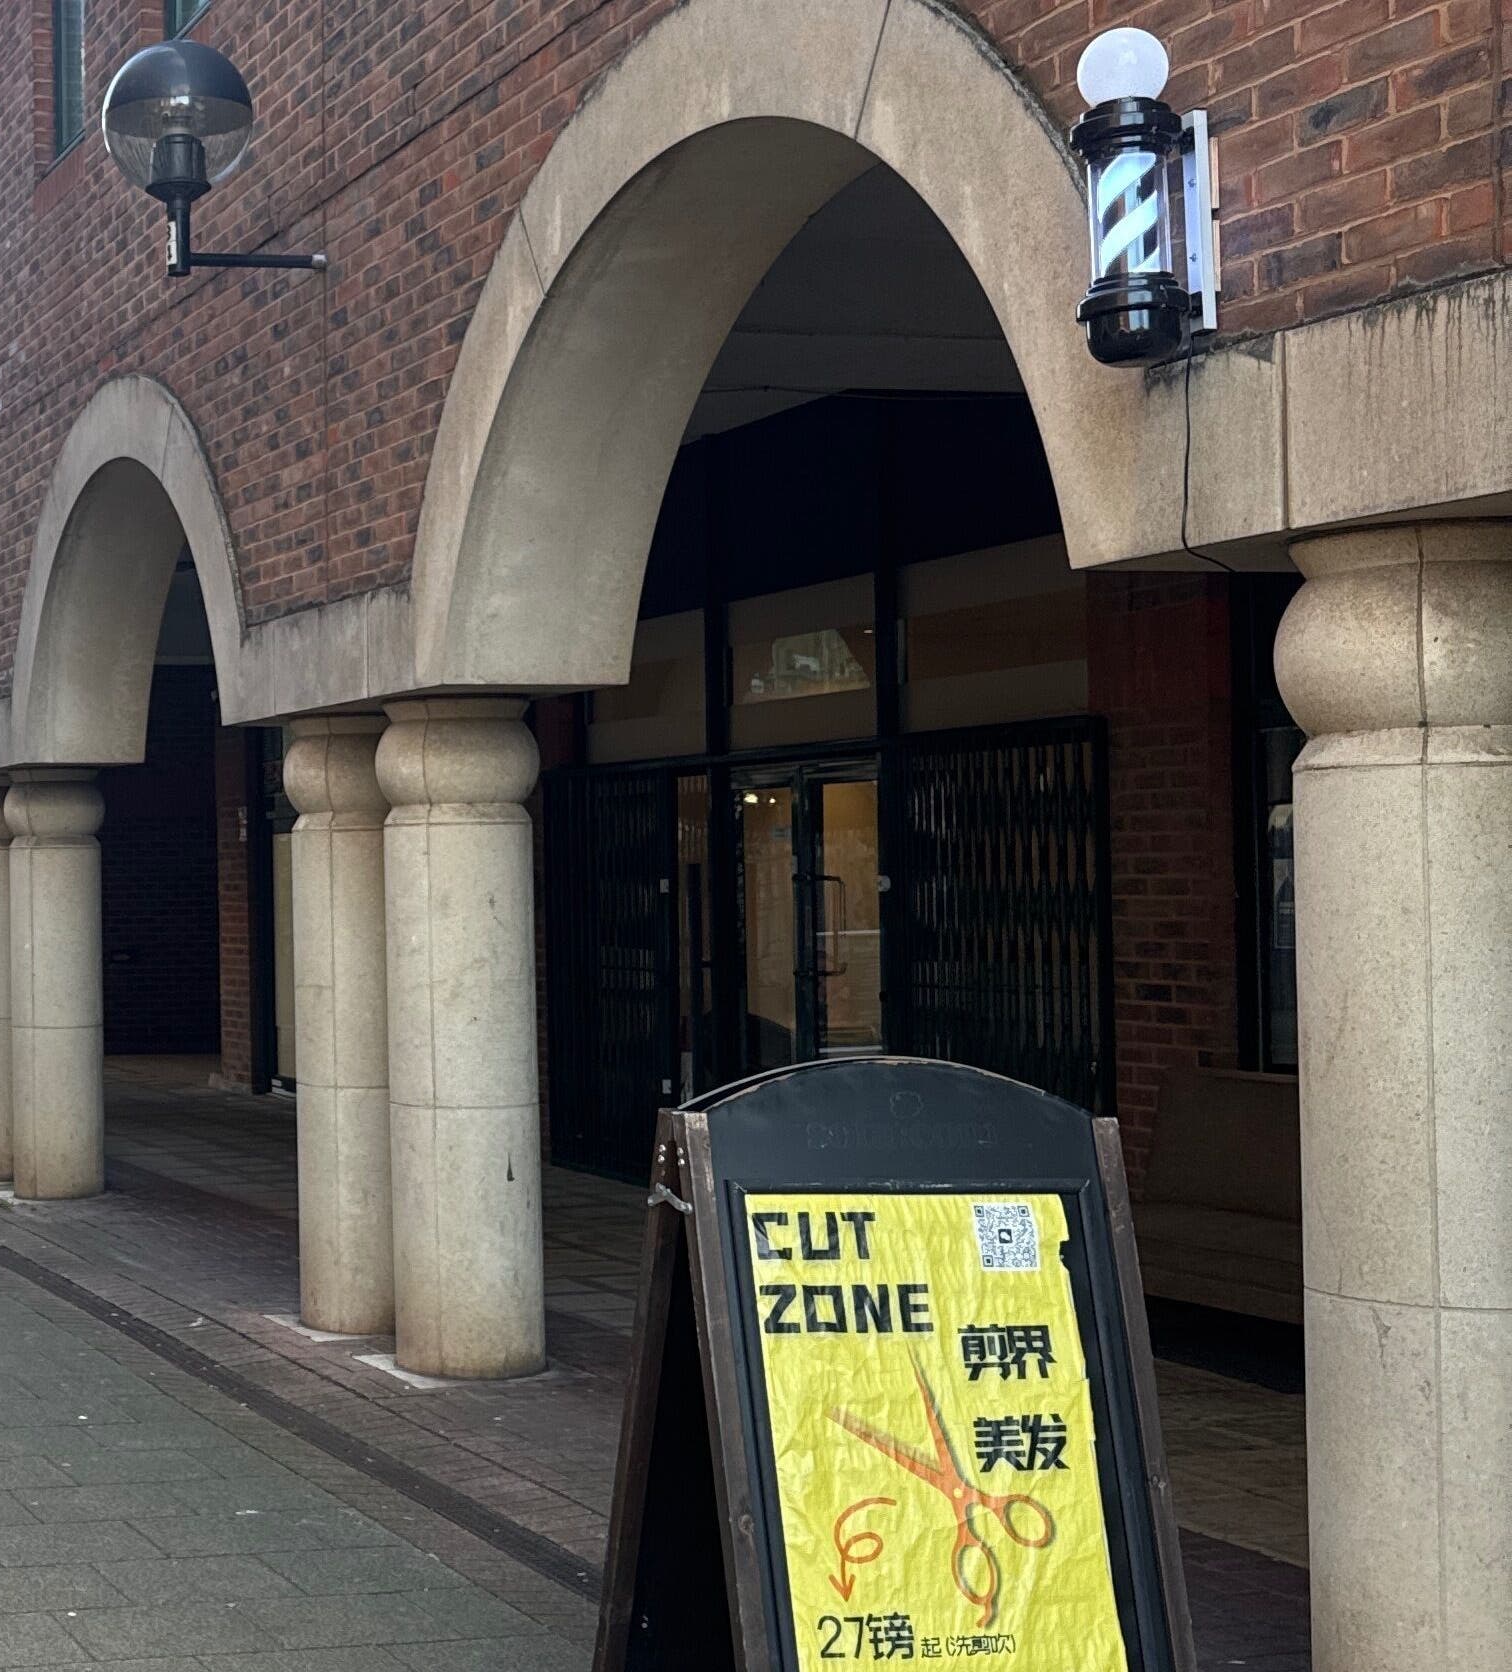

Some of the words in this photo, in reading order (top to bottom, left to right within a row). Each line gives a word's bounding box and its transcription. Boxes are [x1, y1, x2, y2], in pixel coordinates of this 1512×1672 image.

[751, 1211, 876, 1261] CUT
[759, 1283, 933, 1336] ZONE
[958, 1323, 1056, 1382] 剪界
[972, 1413, 1070, 1473] 美发
